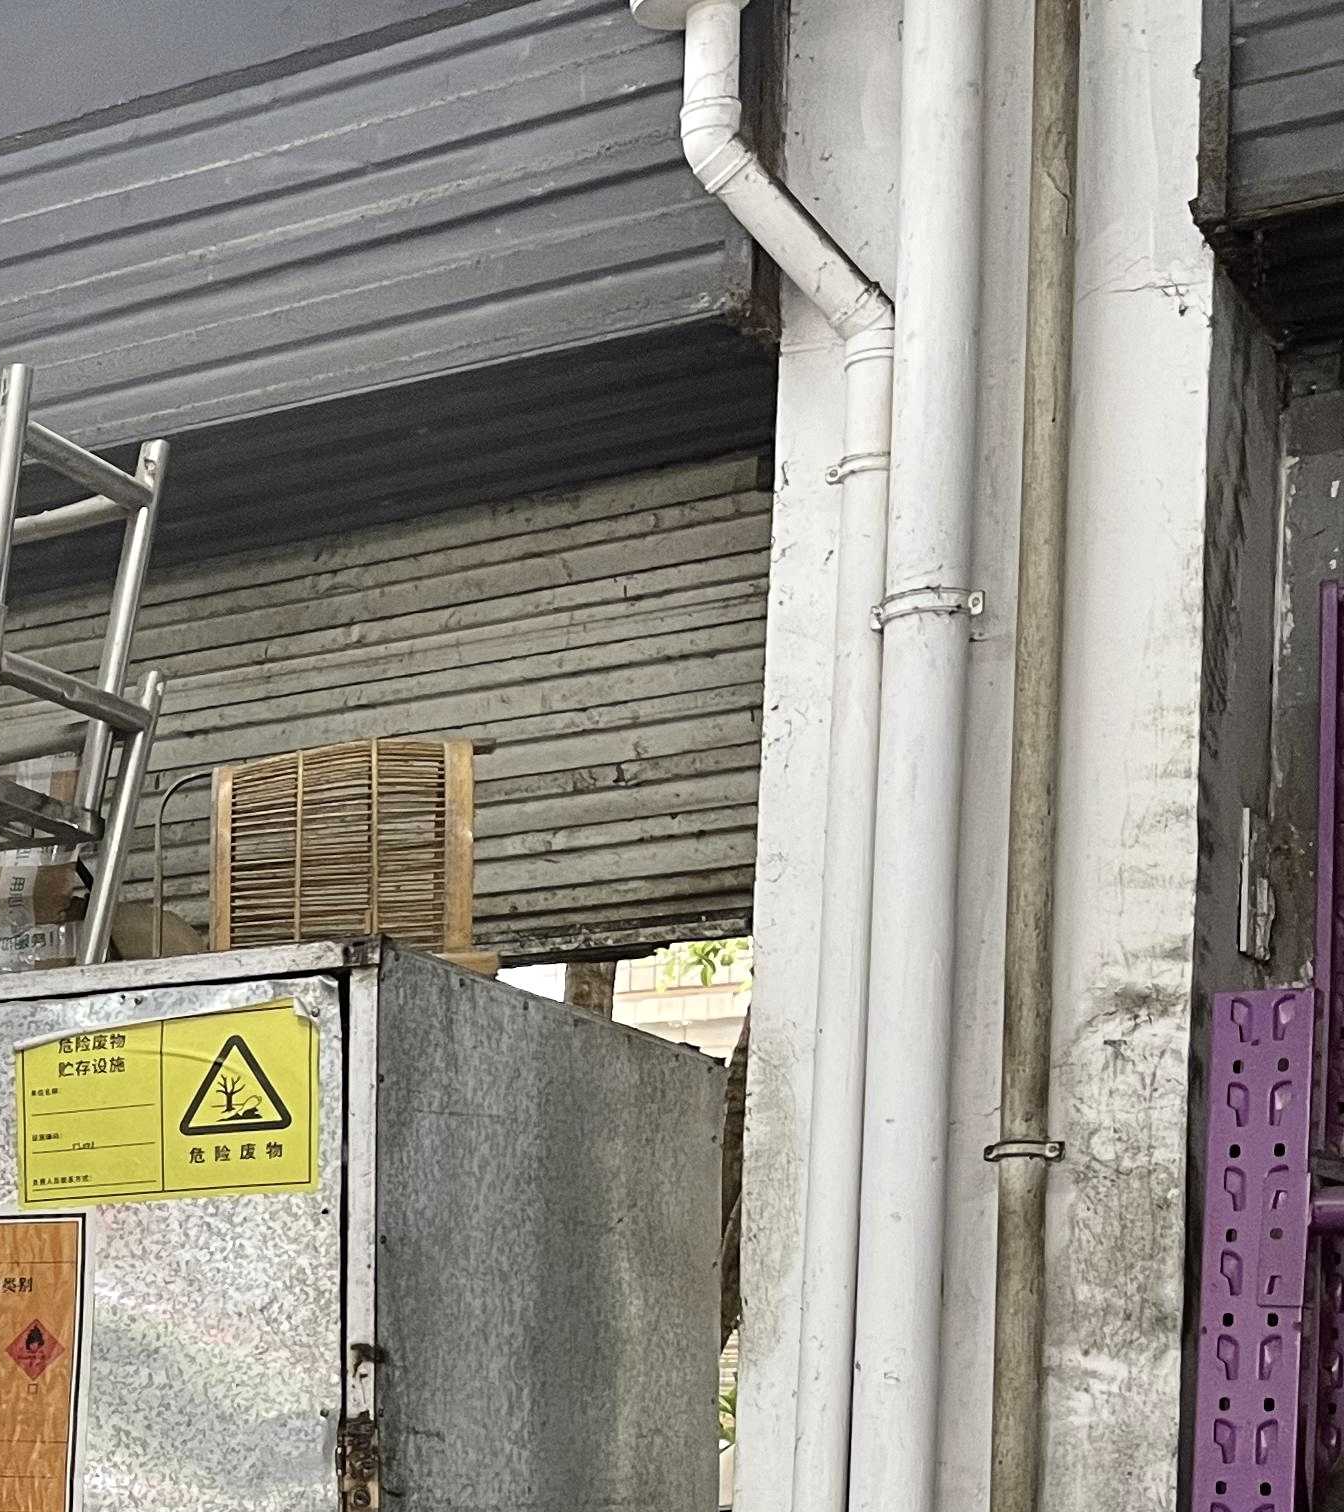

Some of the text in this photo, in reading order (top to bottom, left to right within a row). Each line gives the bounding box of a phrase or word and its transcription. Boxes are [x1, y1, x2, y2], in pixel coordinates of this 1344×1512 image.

[58, 1034, 126, 1054] 危险废物
[58, 1057, 126, 1078] 贮存设施
[189, 1142, 283, 1164] 危险废物
